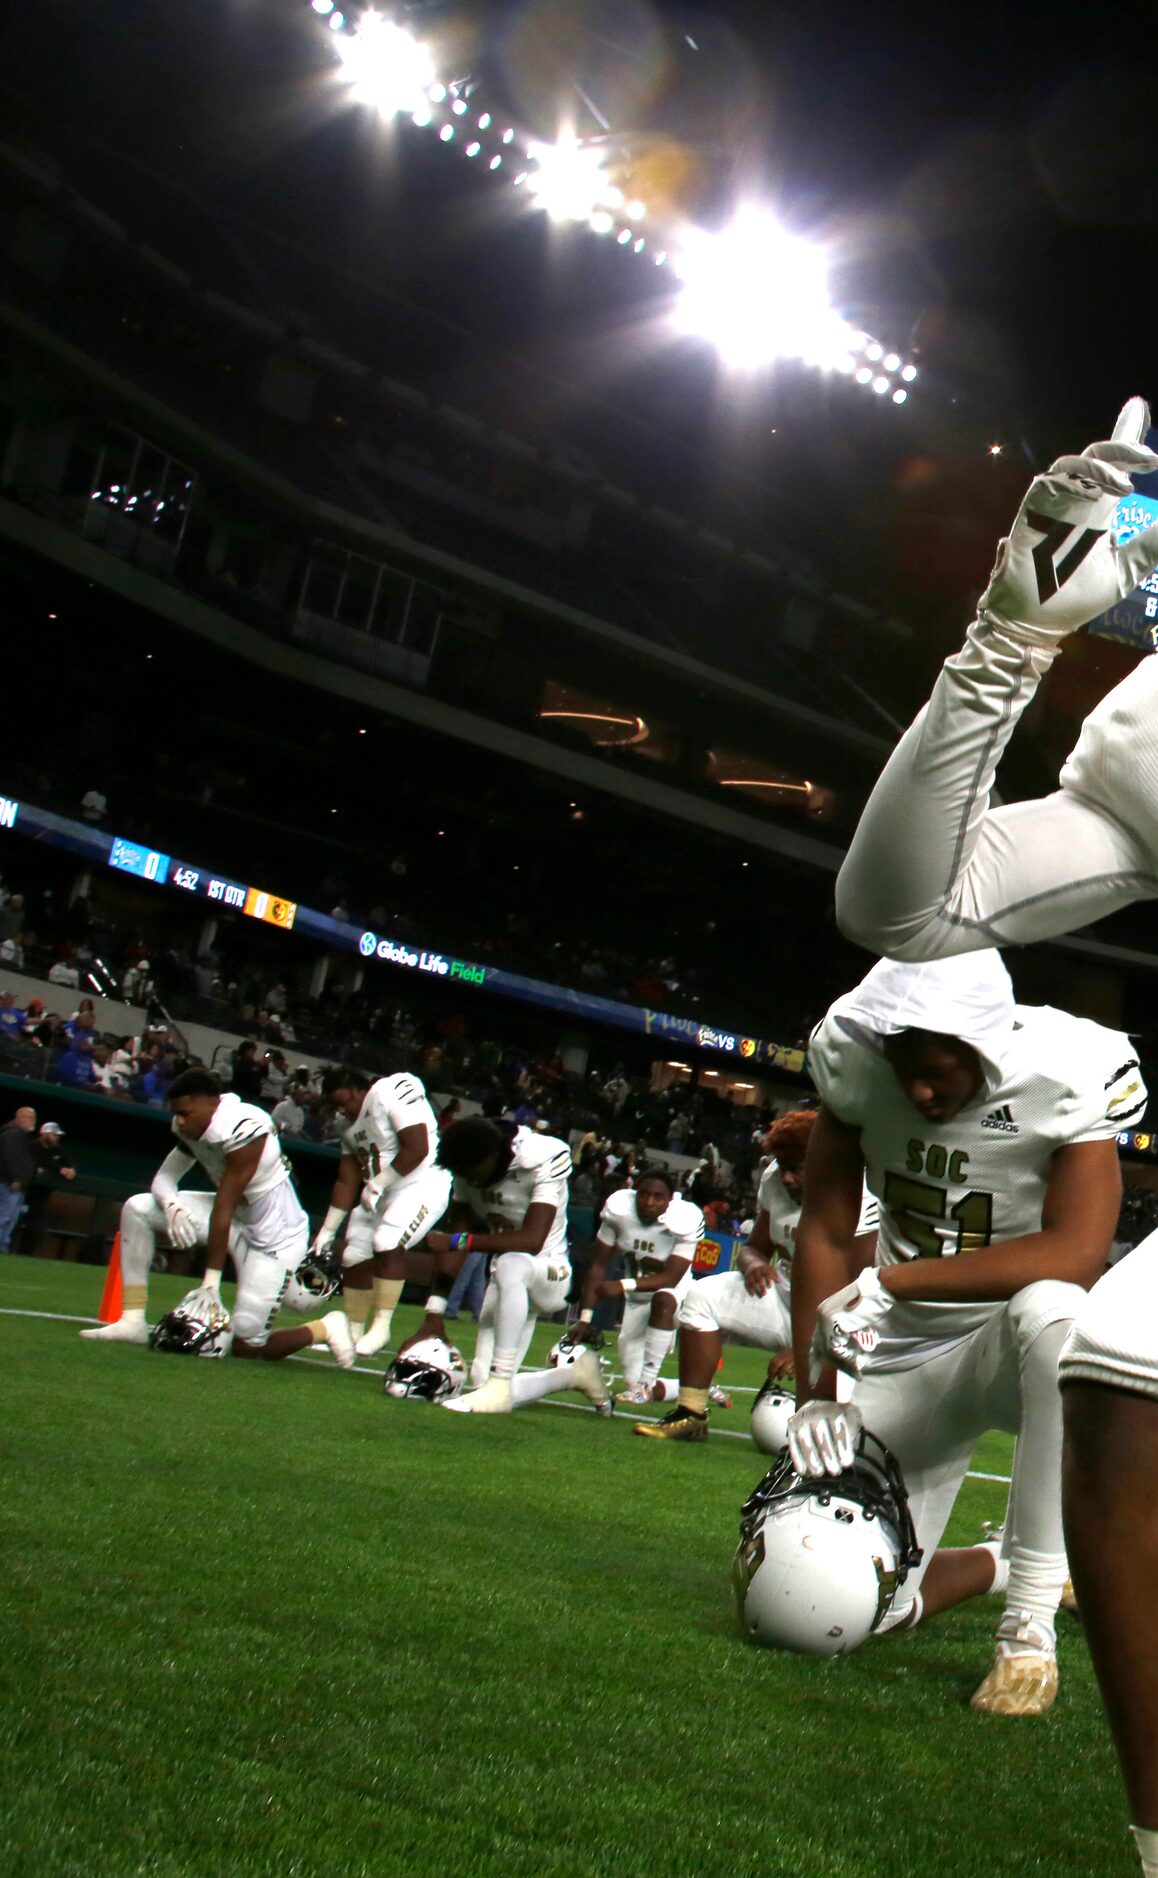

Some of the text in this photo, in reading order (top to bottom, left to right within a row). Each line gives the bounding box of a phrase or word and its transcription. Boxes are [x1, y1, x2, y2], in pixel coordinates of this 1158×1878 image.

[144, 852, 160, 880] 0
[174, 867, 246, 908] 4:52 1ST QTR
[254, 892, 268, 918] 0
[377, 940, 486, 984] Globe Life Field
[718, 1034, 735, 1051] VS
[980, 1118, 1019, 1134] adidas
[906, 1138, 970, 1183] SOC
[884, 1171, 993, 1258] 51
[633, 1238, 655, 1253] SOC
